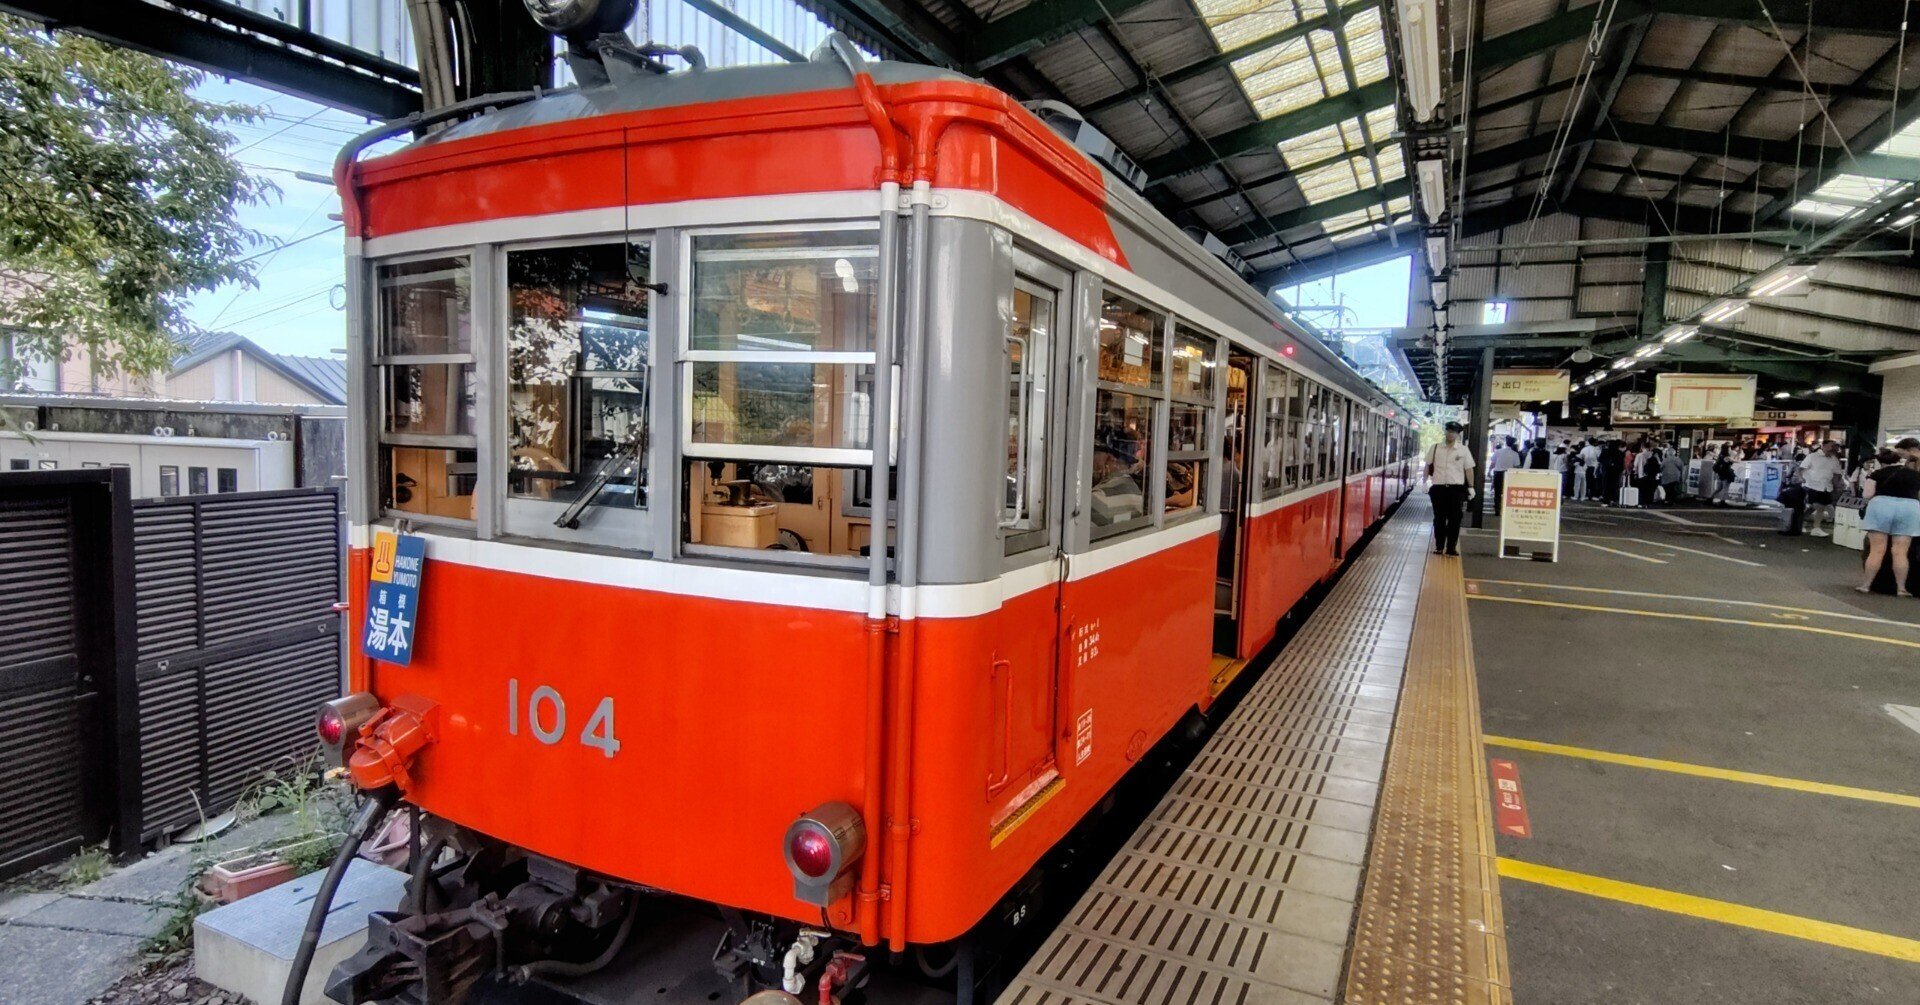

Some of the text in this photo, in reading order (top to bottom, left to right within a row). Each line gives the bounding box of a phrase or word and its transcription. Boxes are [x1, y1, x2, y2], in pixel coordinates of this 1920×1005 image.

[1502, 381, 1521, 389] 出口
[395, 555, 419, 571] HAKONE
[393, 572, 417, 588] YUMOTO
[367, 606, 411, 656] 湯本
[509, 678, 621, 758] 104
